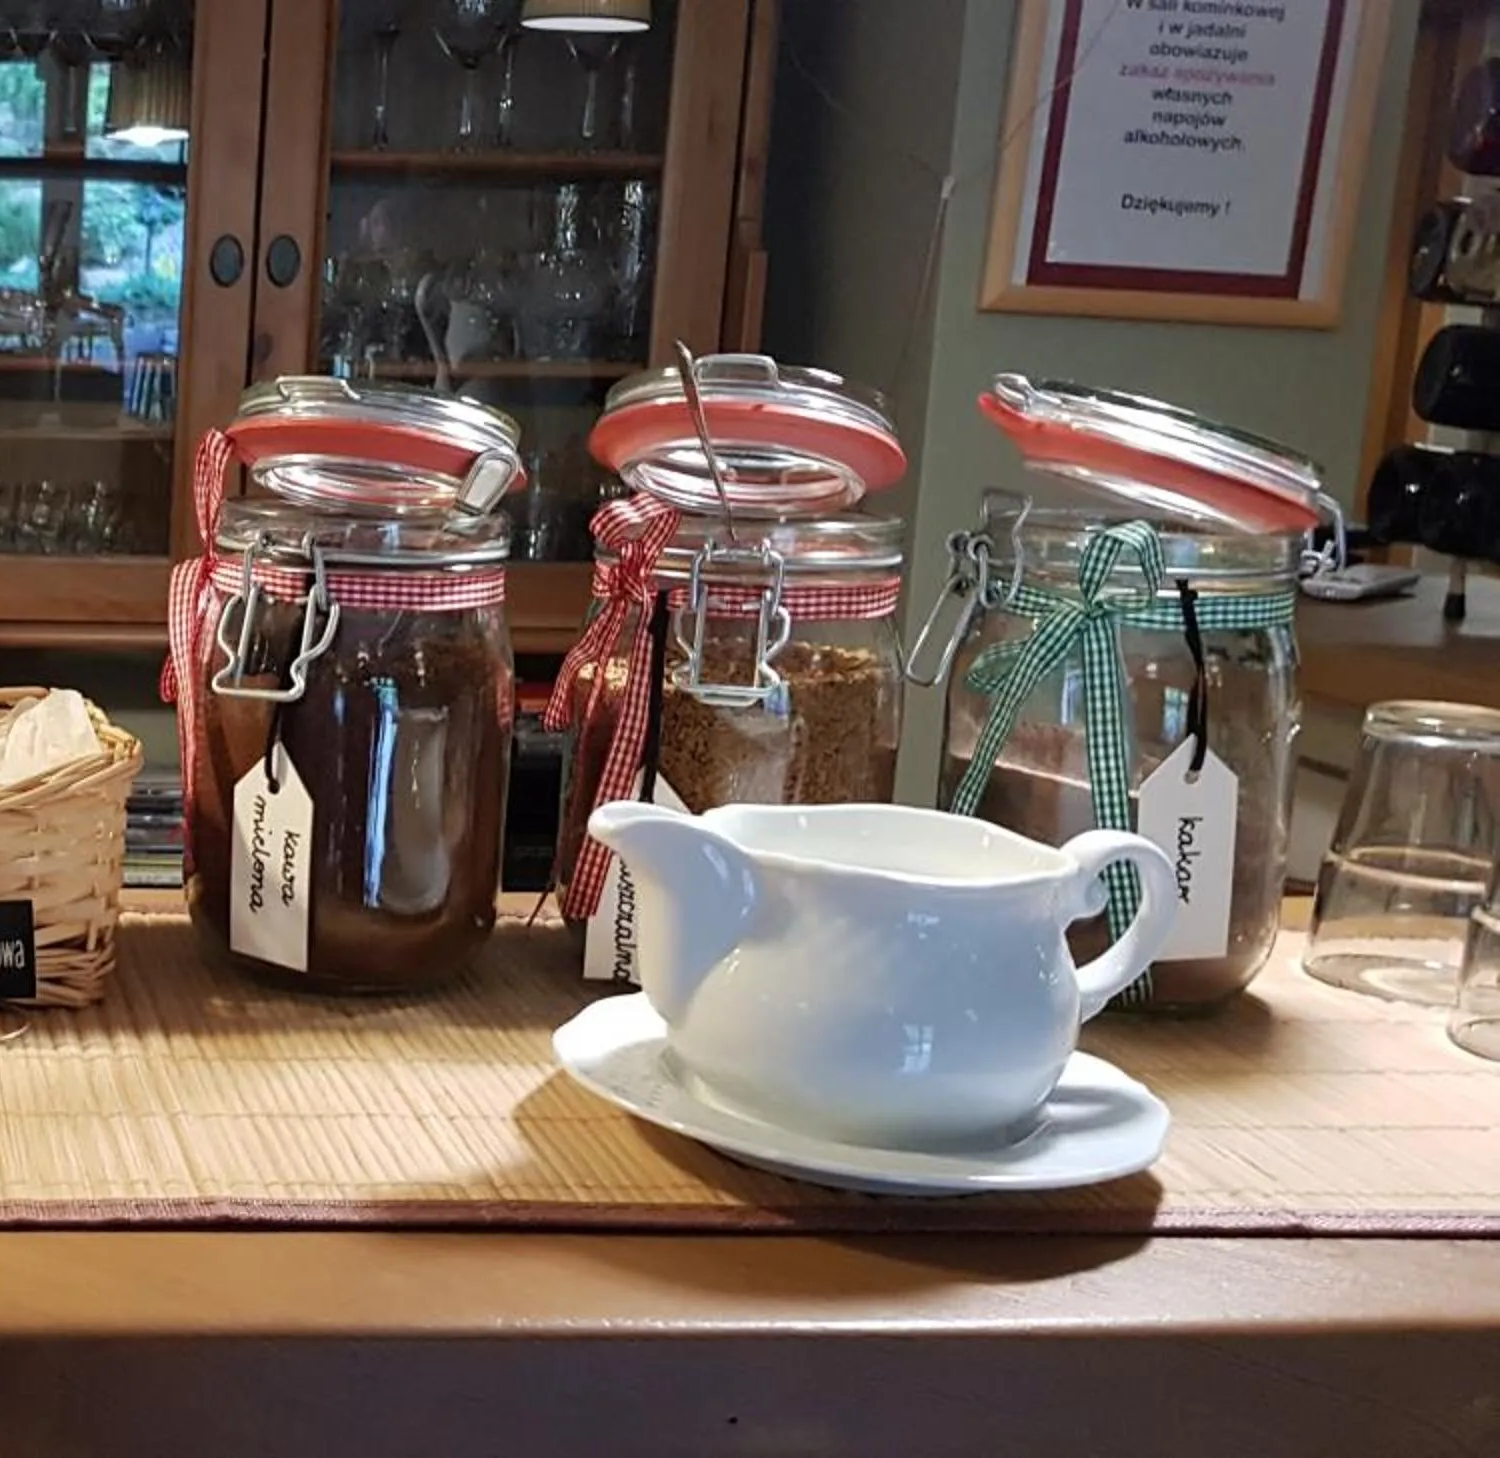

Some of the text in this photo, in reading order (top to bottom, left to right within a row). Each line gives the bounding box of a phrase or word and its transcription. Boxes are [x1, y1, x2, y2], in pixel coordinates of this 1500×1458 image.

[1168, 24, 1185, 35] w
[1185, 21, 1247, 39] jadalni
[1151, 87, 1233, 107] własnych
[1151, 110, 1227, 130] napojów
[1120, 193, 1221, 217] Dziękujemy
[249, 794, 273, 915] mielona
